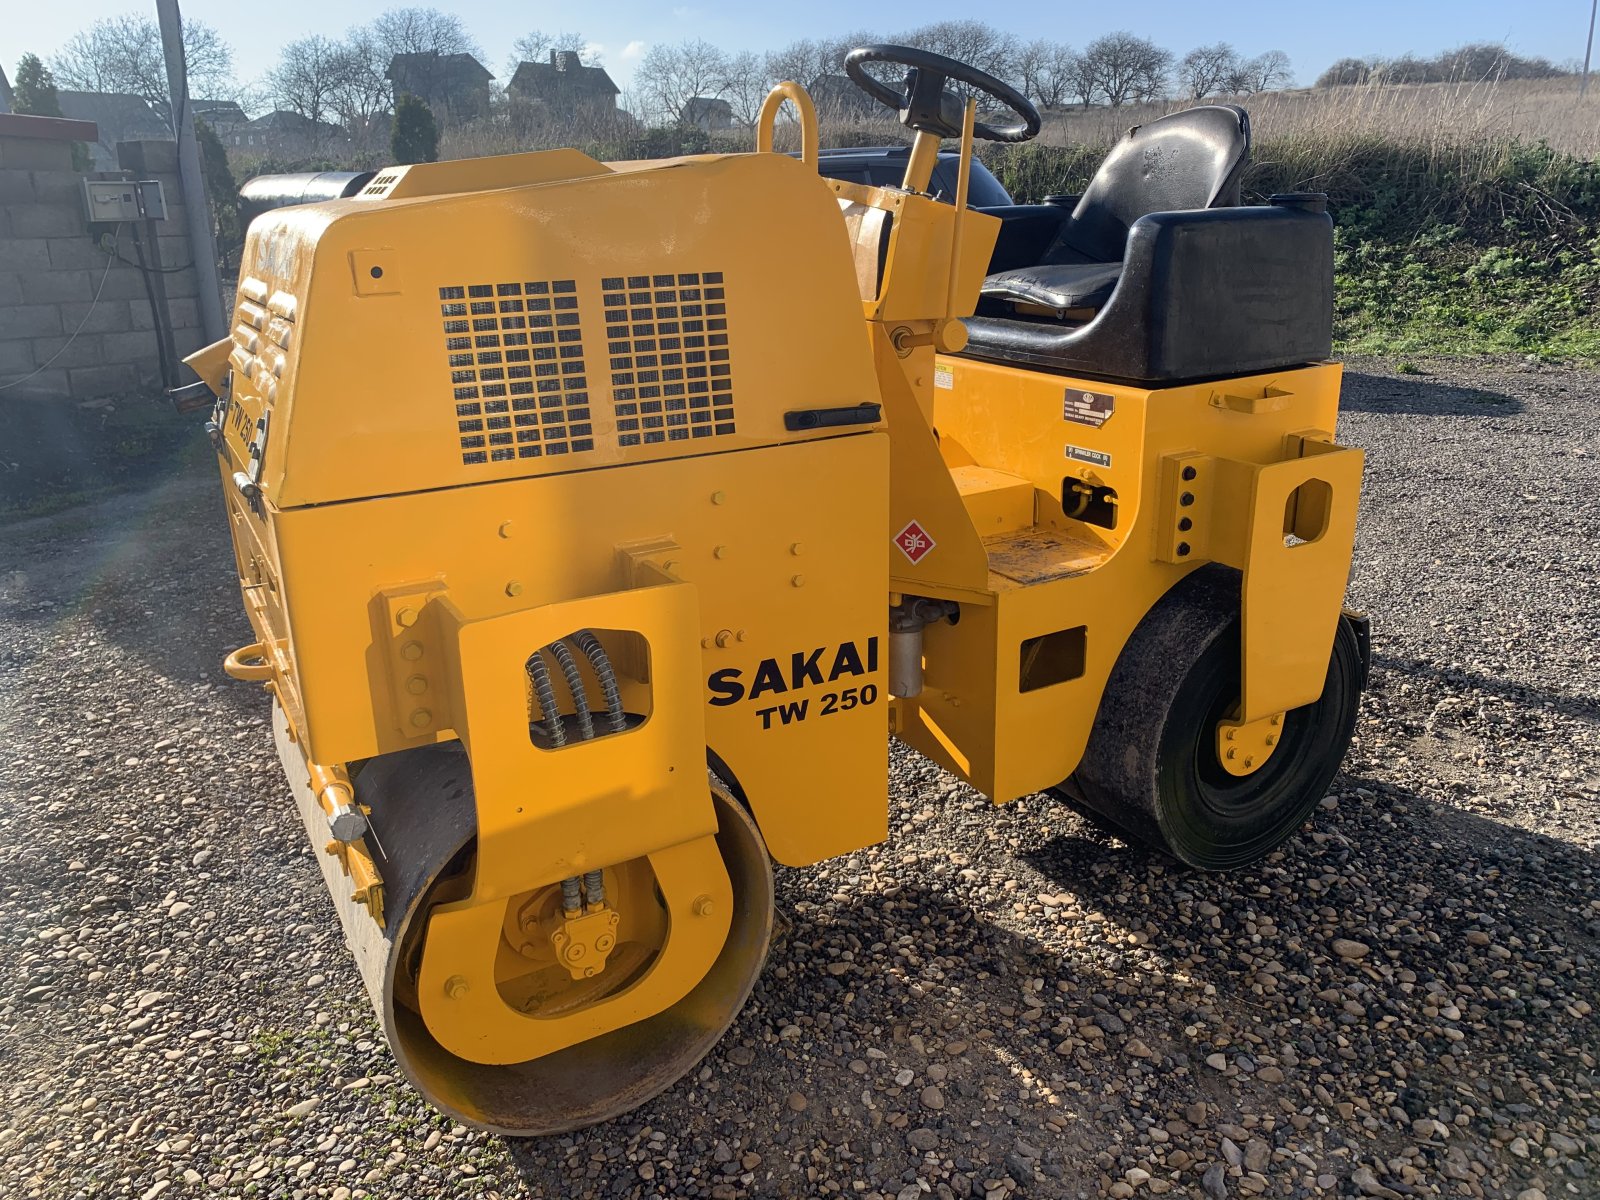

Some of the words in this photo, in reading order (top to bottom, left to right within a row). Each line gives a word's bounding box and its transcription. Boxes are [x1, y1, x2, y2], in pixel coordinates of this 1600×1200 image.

[231, 400, 245, 432] TW
[240, 413, 254, 447] 250
[707, 636, 878, 706] SAKAI
[755, 699, 809, 730] TW
[820, 684, 878, 716] 250
